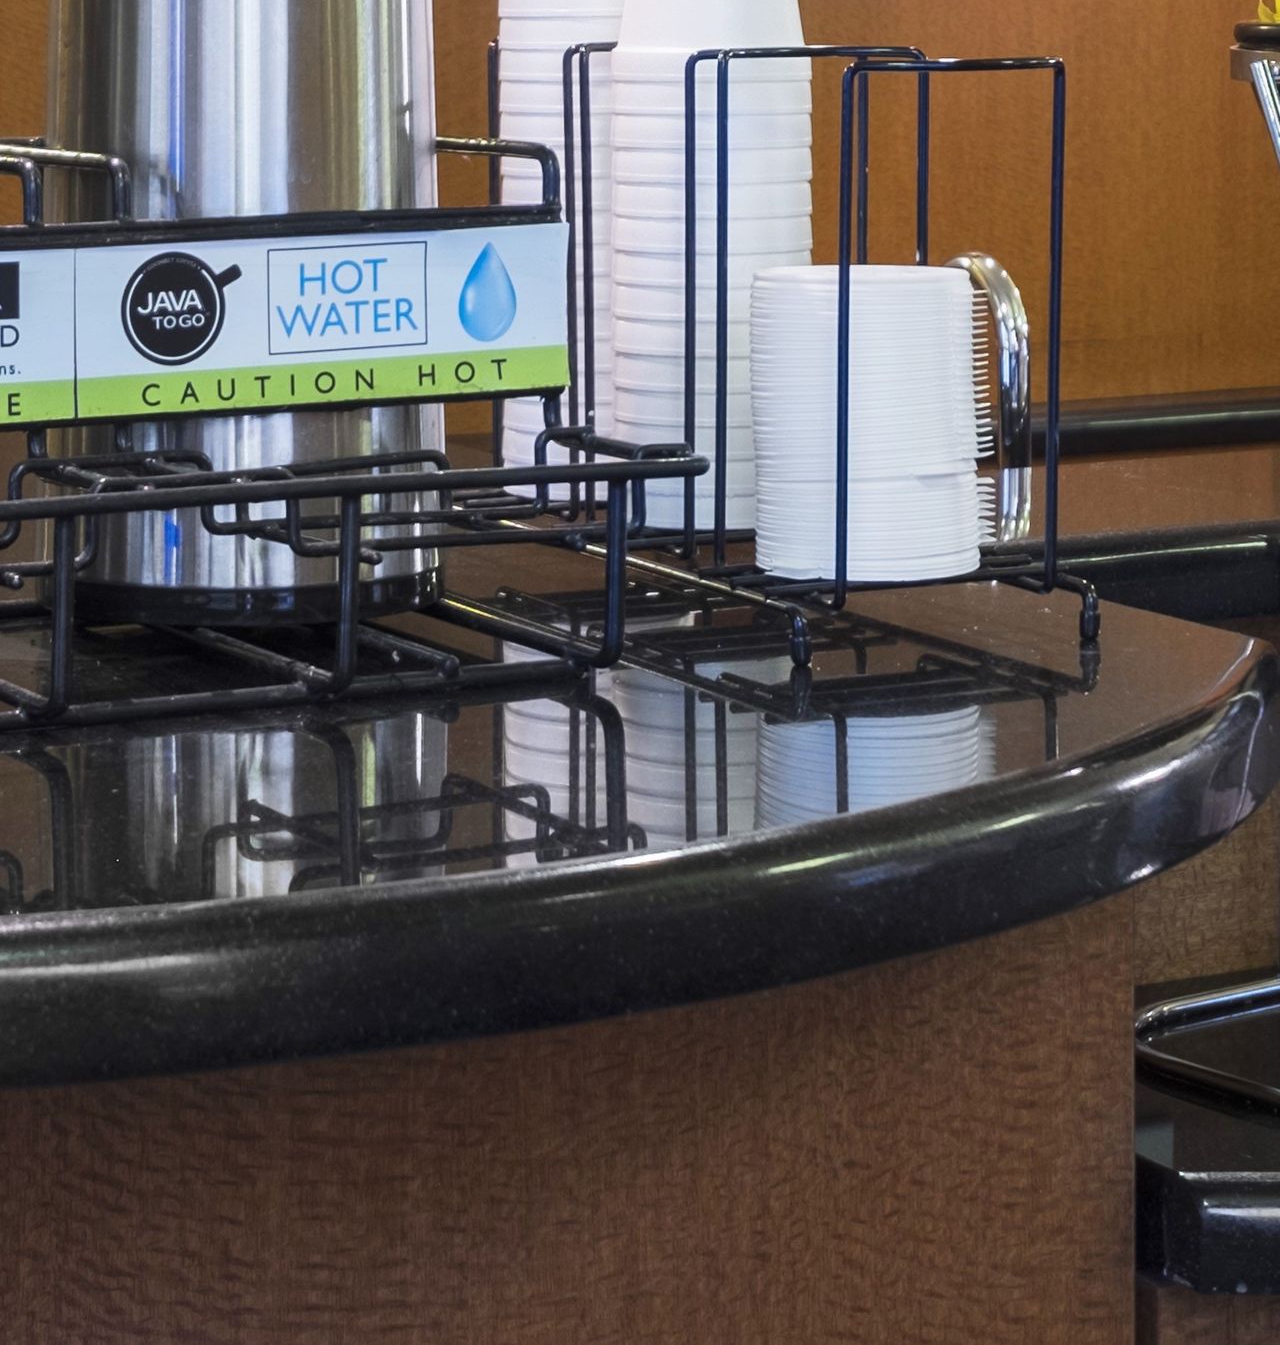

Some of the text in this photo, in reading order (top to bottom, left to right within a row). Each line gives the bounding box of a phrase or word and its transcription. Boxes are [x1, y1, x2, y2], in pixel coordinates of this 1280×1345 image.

[299, 258, 388, 296] HOT
[137, 289, 202, 314] JAVA
[277, 298, 418, 339] WATER
[152, 313, 205, 330] TO GO
[141, 358, 508, 407] CAUTION HOT
